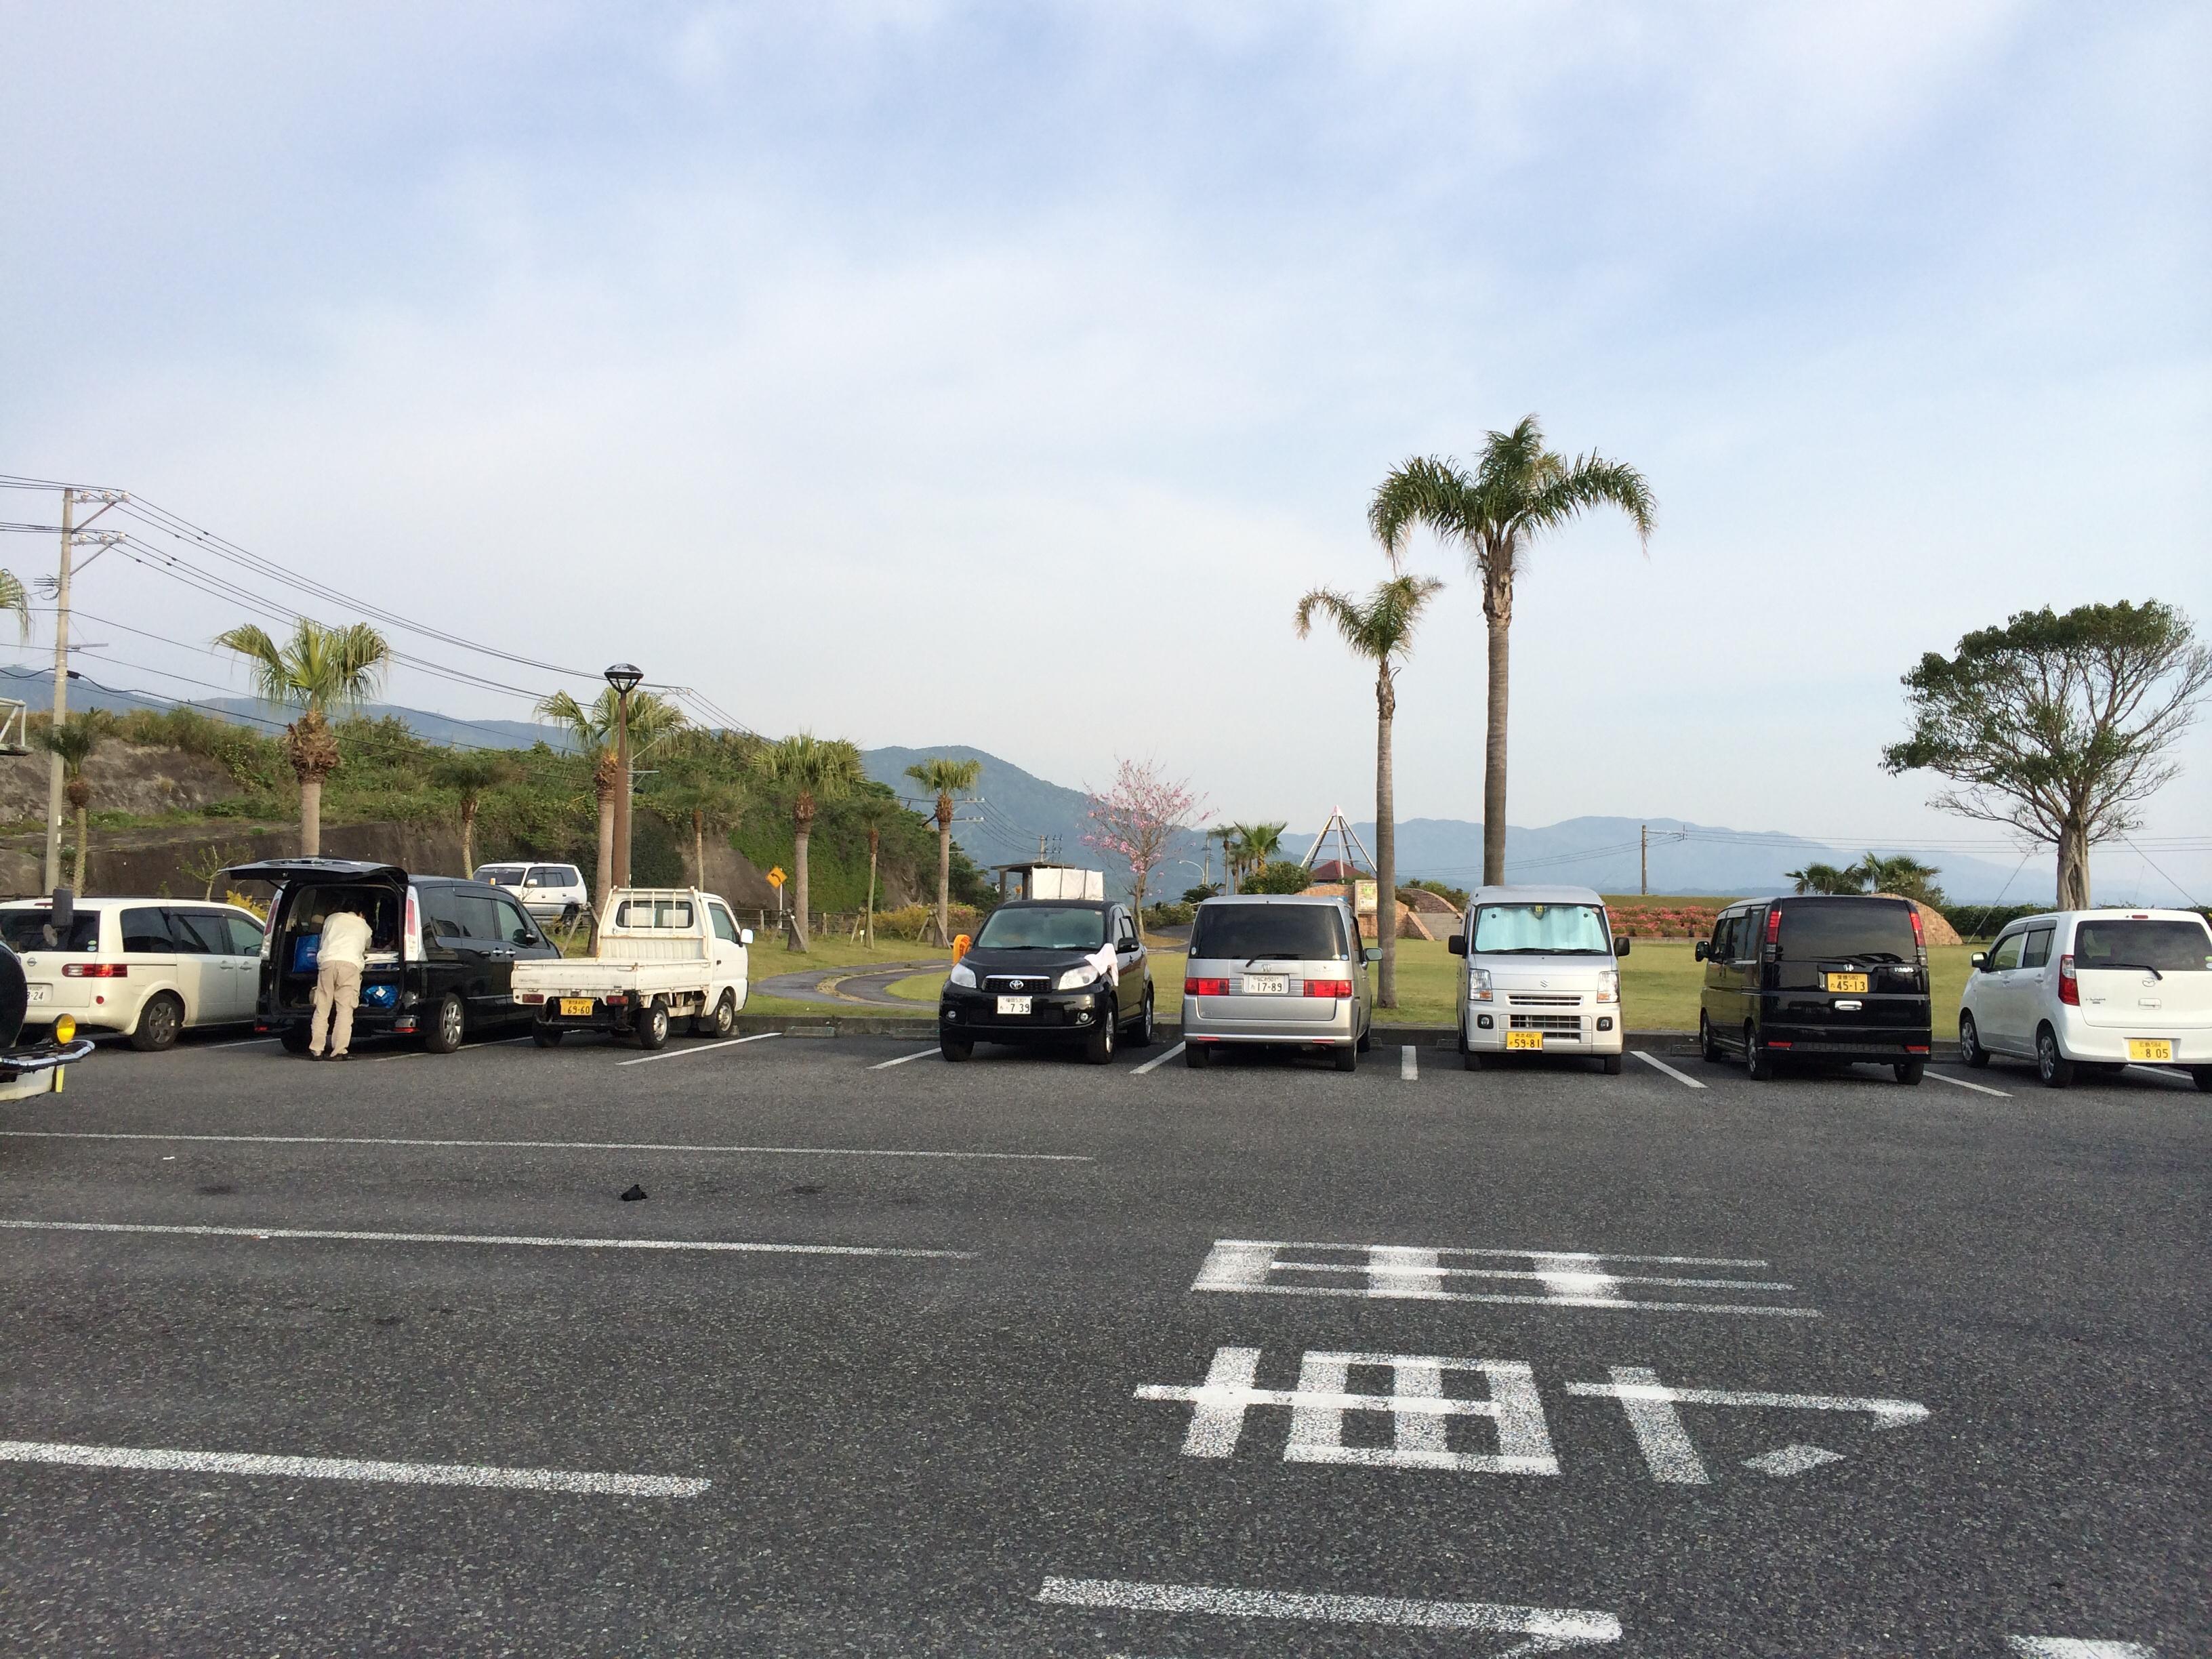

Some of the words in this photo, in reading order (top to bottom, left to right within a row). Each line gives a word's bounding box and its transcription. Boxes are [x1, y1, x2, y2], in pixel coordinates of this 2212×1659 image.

[1257, 982, 1282, 992] 17-89
[1837, 981, 1865, 991] 45-13
[567, 1005, 590, 1014] 69-60
[1514, 1039, 1540, 1048] 59-81
